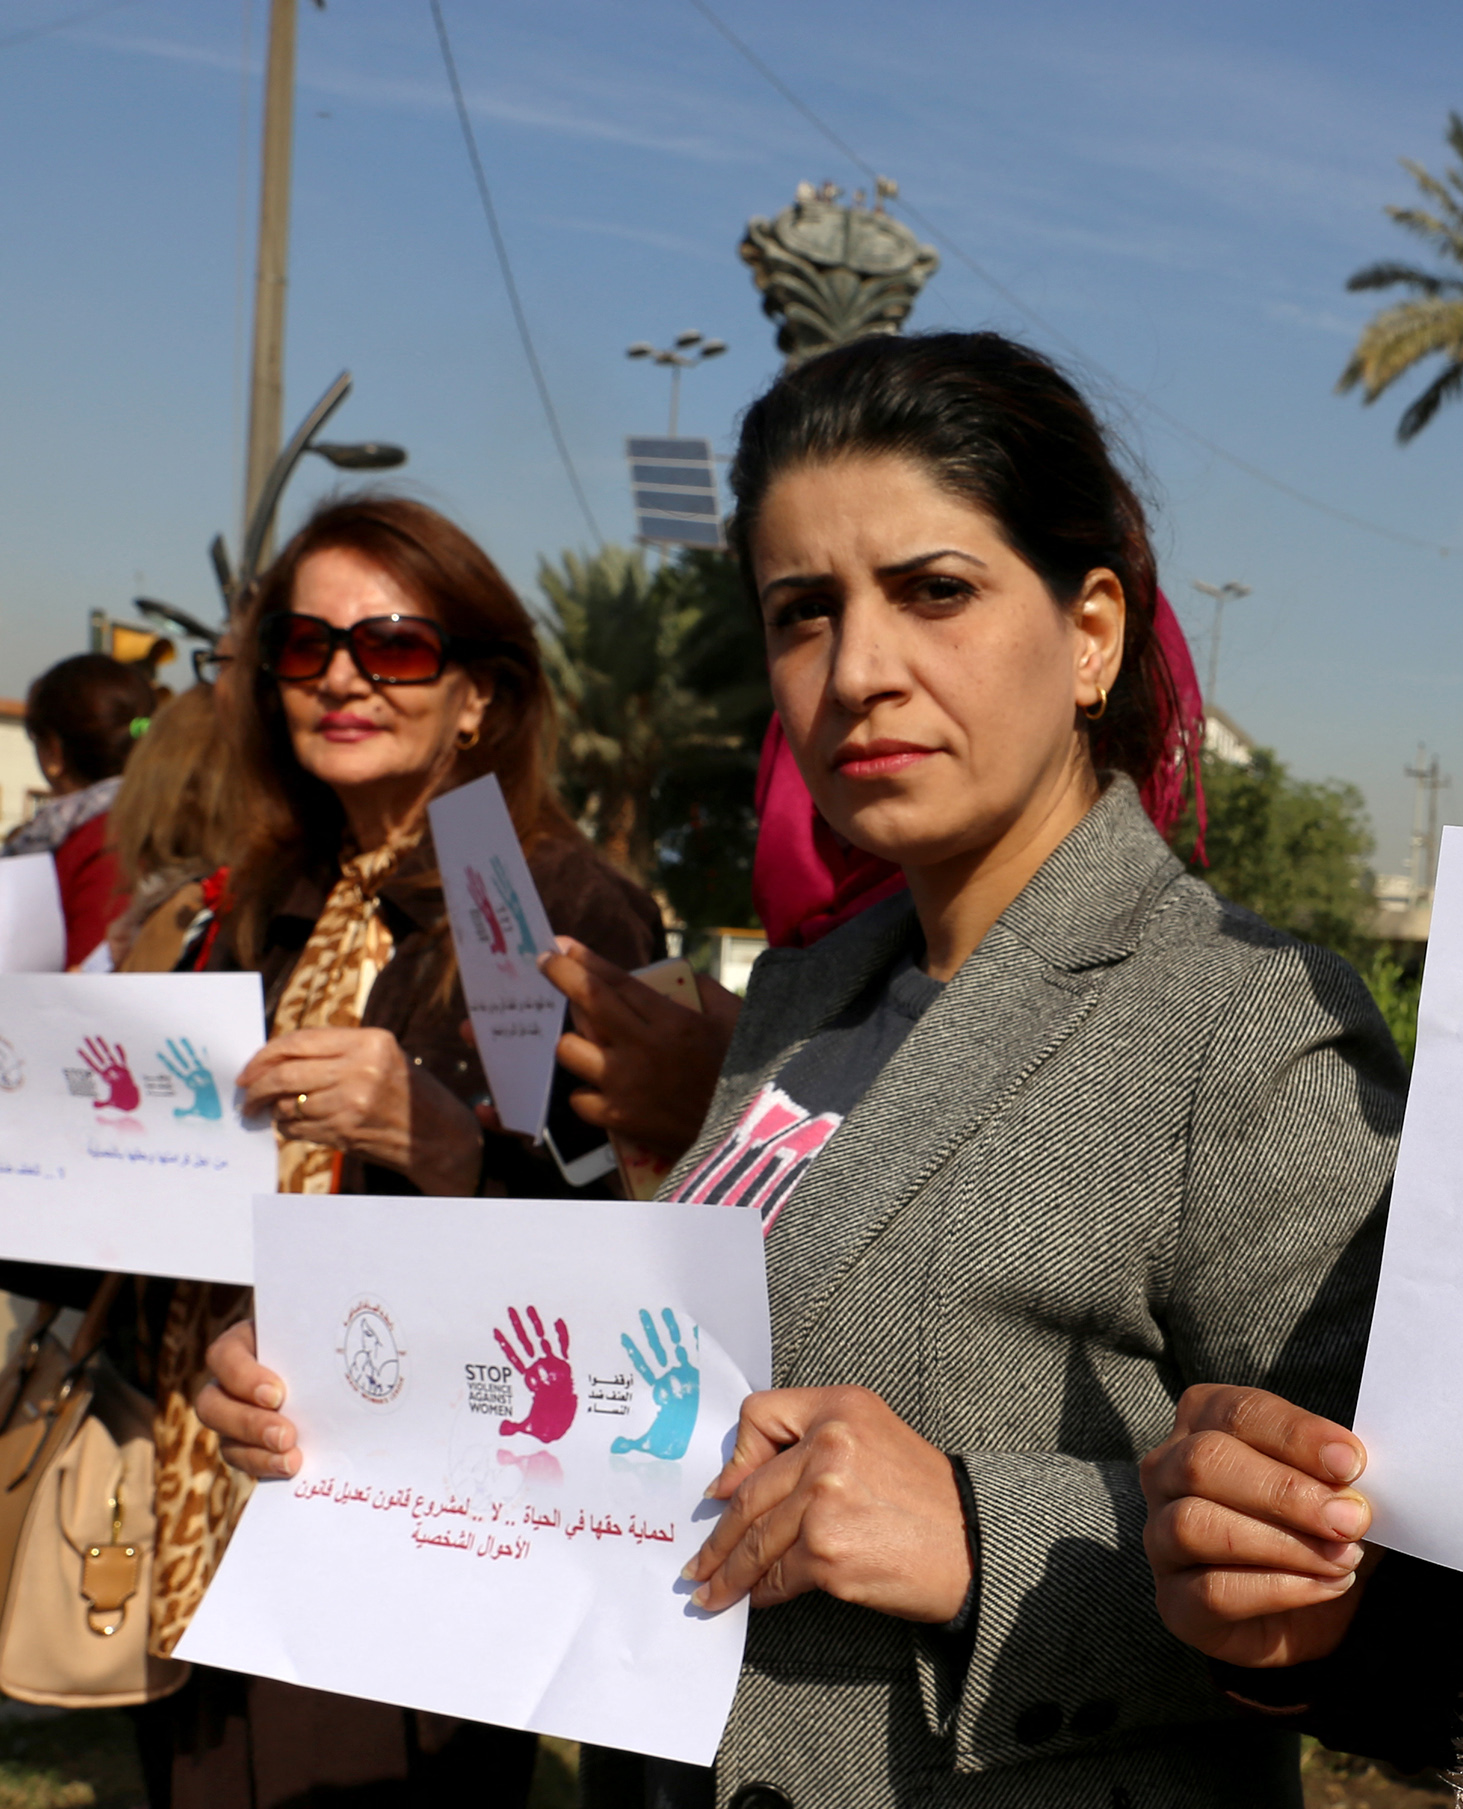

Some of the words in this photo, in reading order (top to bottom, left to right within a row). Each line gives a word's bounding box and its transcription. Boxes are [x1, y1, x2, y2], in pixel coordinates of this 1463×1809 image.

[465, 1364, 512, 1383] STOP
[468, 1382, 512, 1394] VIOLENCE
[469, 1392, 512, 1404] AGAINST
[469, 1402, 513, 1416] WOMEN
[294, 1478, 335, 1499] قانون
[334, 1482, 371, 1505] تعديل
[372, 1486, 413, 1510] قانون
[411, 1495, 470, 1518] لمشروع
[491, 1502, 503, 1522] لا
[523, 1505, 561, 1531] الحياة
[411, 1521, 475, 1551] الشخصية
[565, 1509, 585, 1541] في
[590, 1513, 623, 1541] حقها
[628, 1515, 675, 1544] لحماية
